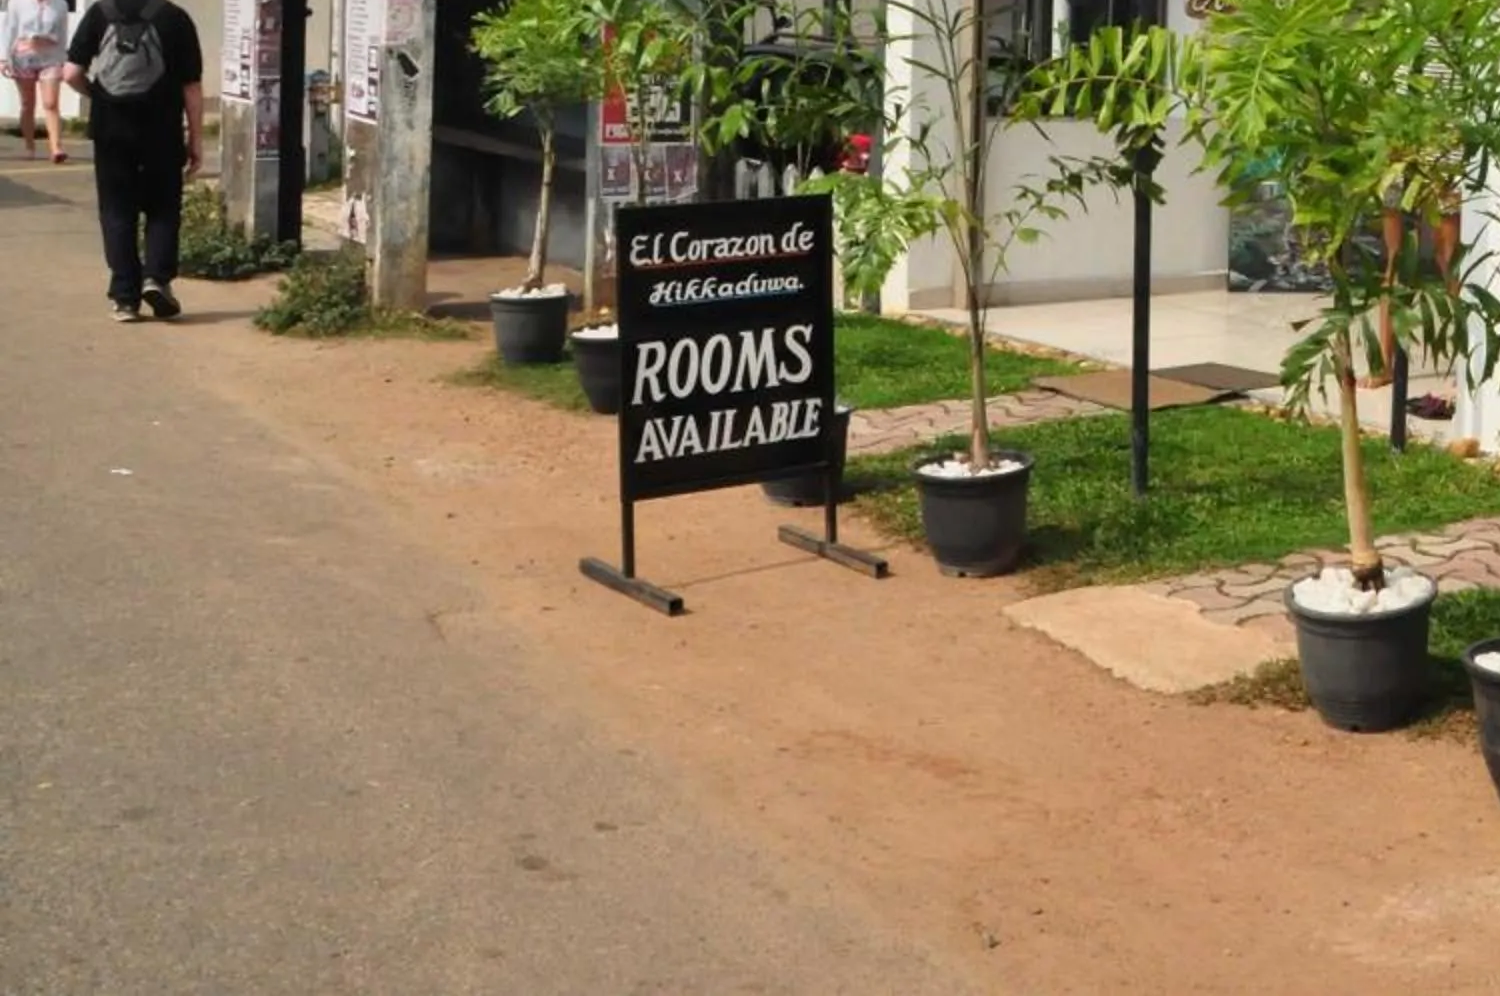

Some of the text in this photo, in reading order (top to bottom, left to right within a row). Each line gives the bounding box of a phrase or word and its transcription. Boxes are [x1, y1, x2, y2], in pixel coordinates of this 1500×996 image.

[629, 221, 815, 267] El Corazon de
[631, 324, 814, 405] ROOMS
[633, 397, 823, 464] AVAILABLE
